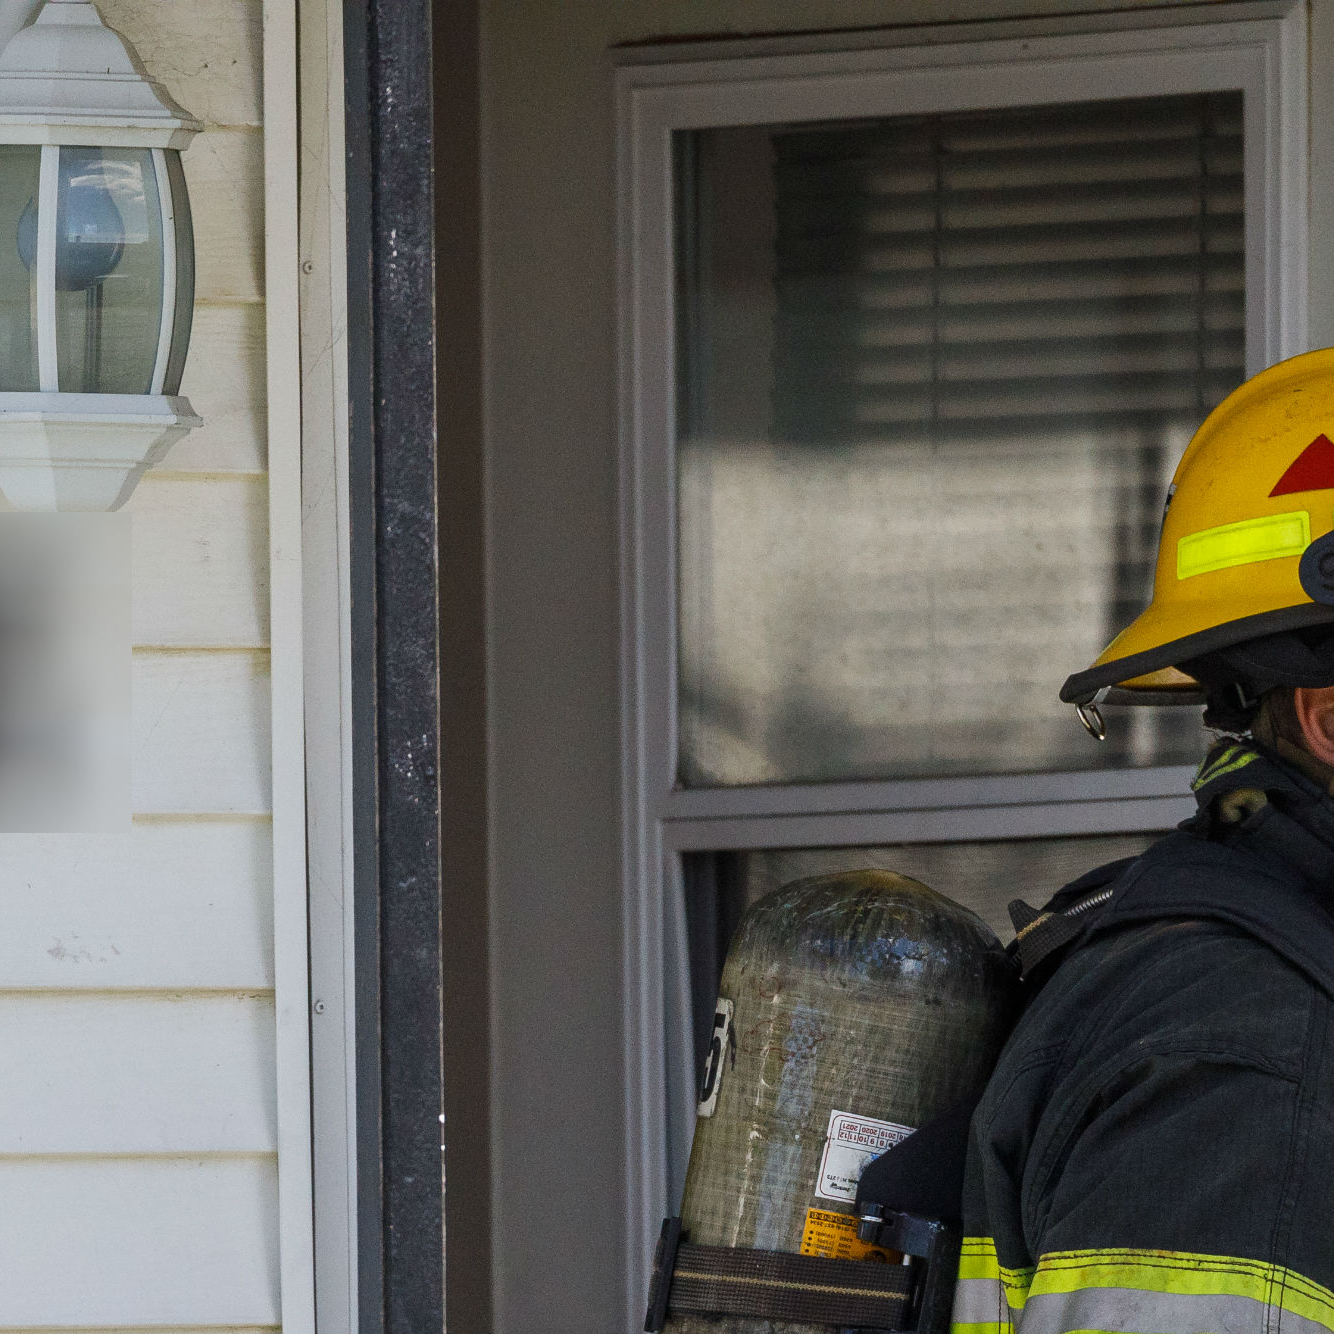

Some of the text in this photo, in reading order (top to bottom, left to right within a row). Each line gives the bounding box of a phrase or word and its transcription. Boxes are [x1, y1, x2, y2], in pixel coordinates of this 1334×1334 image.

[842, 1122, 859, 1132] 2021
[861, 1126, 879, 1136] 2020
[839, 1131, 848, 1139] 12
[880, 1130, 897, 1140] 2019
